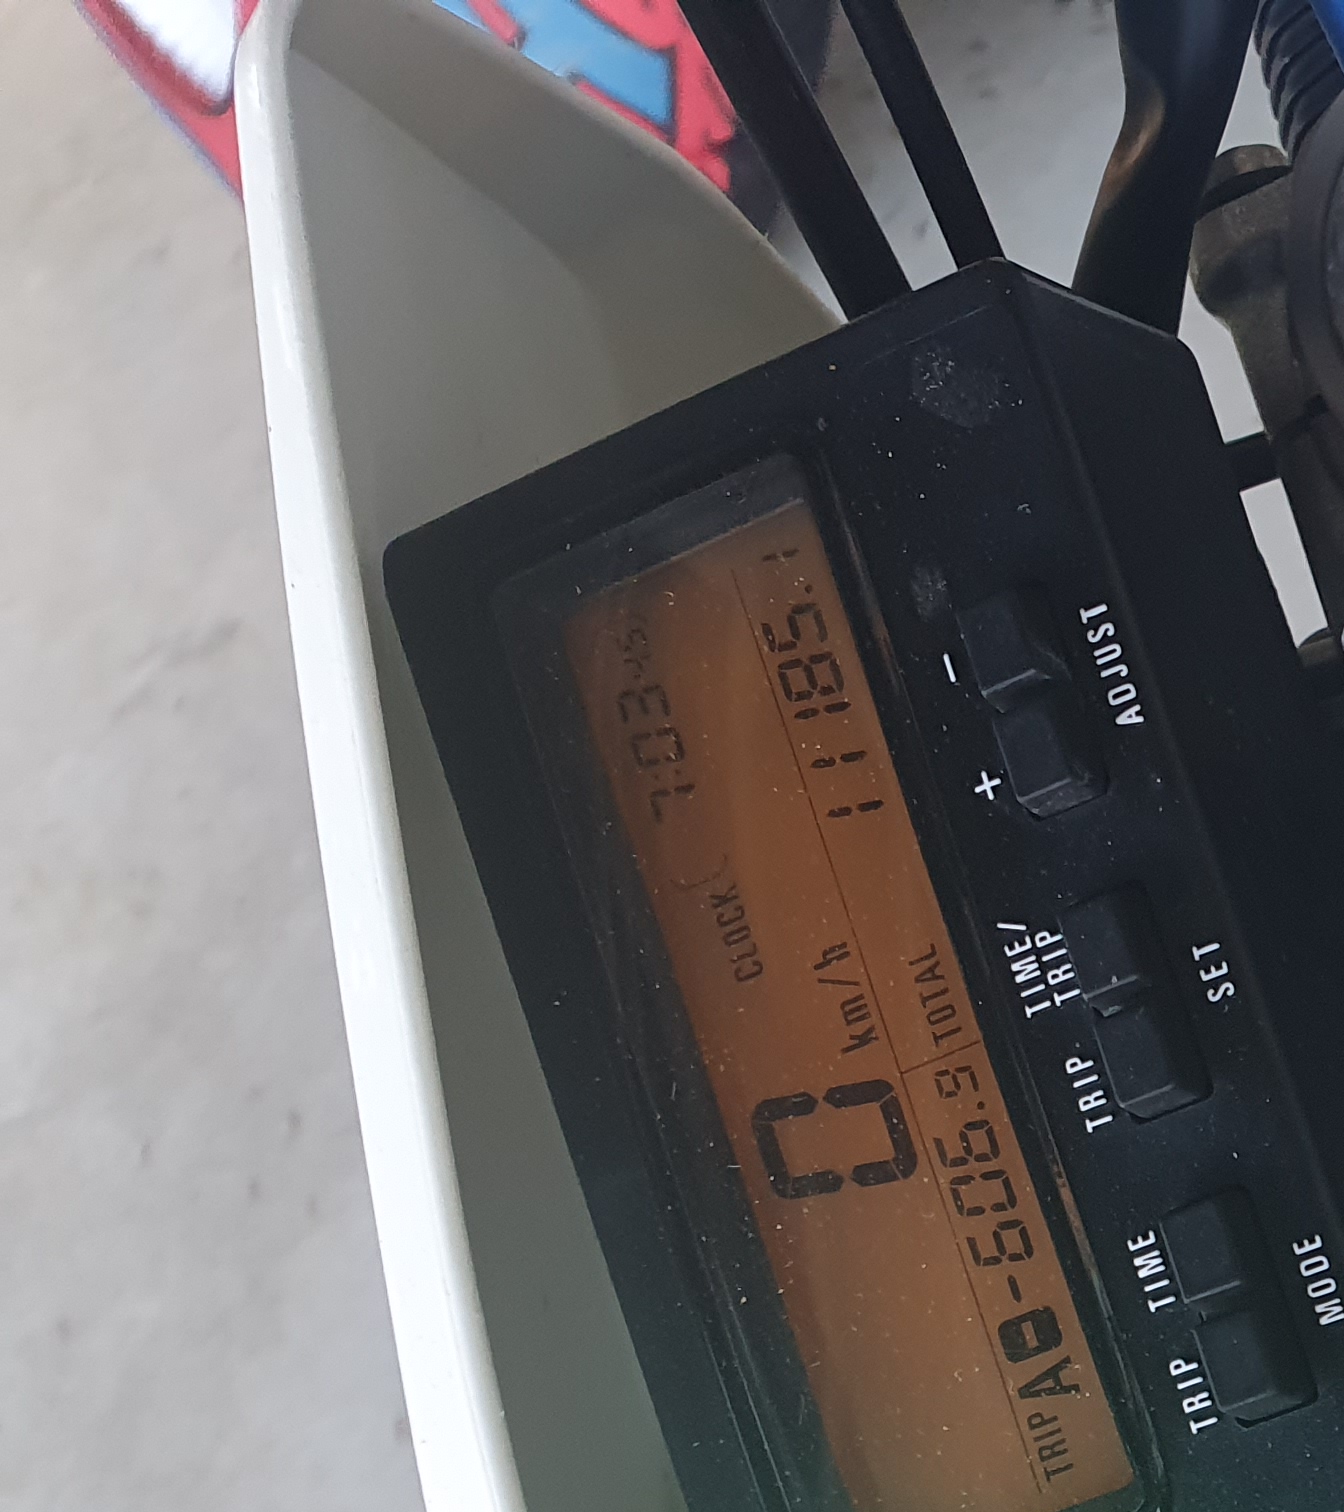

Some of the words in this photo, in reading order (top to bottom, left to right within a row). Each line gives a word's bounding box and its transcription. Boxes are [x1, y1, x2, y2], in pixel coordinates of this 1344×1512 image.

[1079, 603, 1144, 725] ADJUST
[708, 881, 764, 983] CLOCK
[995, 921, 1051, 1018] TIME/
[1033, 930, 1081, 1007] TRIP
[1191, 942, 1235, 1002] SET
[812, 940, 880, 1054] km/h
[907, 941, 963, 1048] TOTAL
[749, 1077, 918, 1201] 0
[1064, 1056, 1113, 1133] TRIP
[1126, 1230, 1176, 1313] TIME
[1168, 1358, 1218, 1434] TRIP
[1026, 1411, 1074, 1483] TRIP
